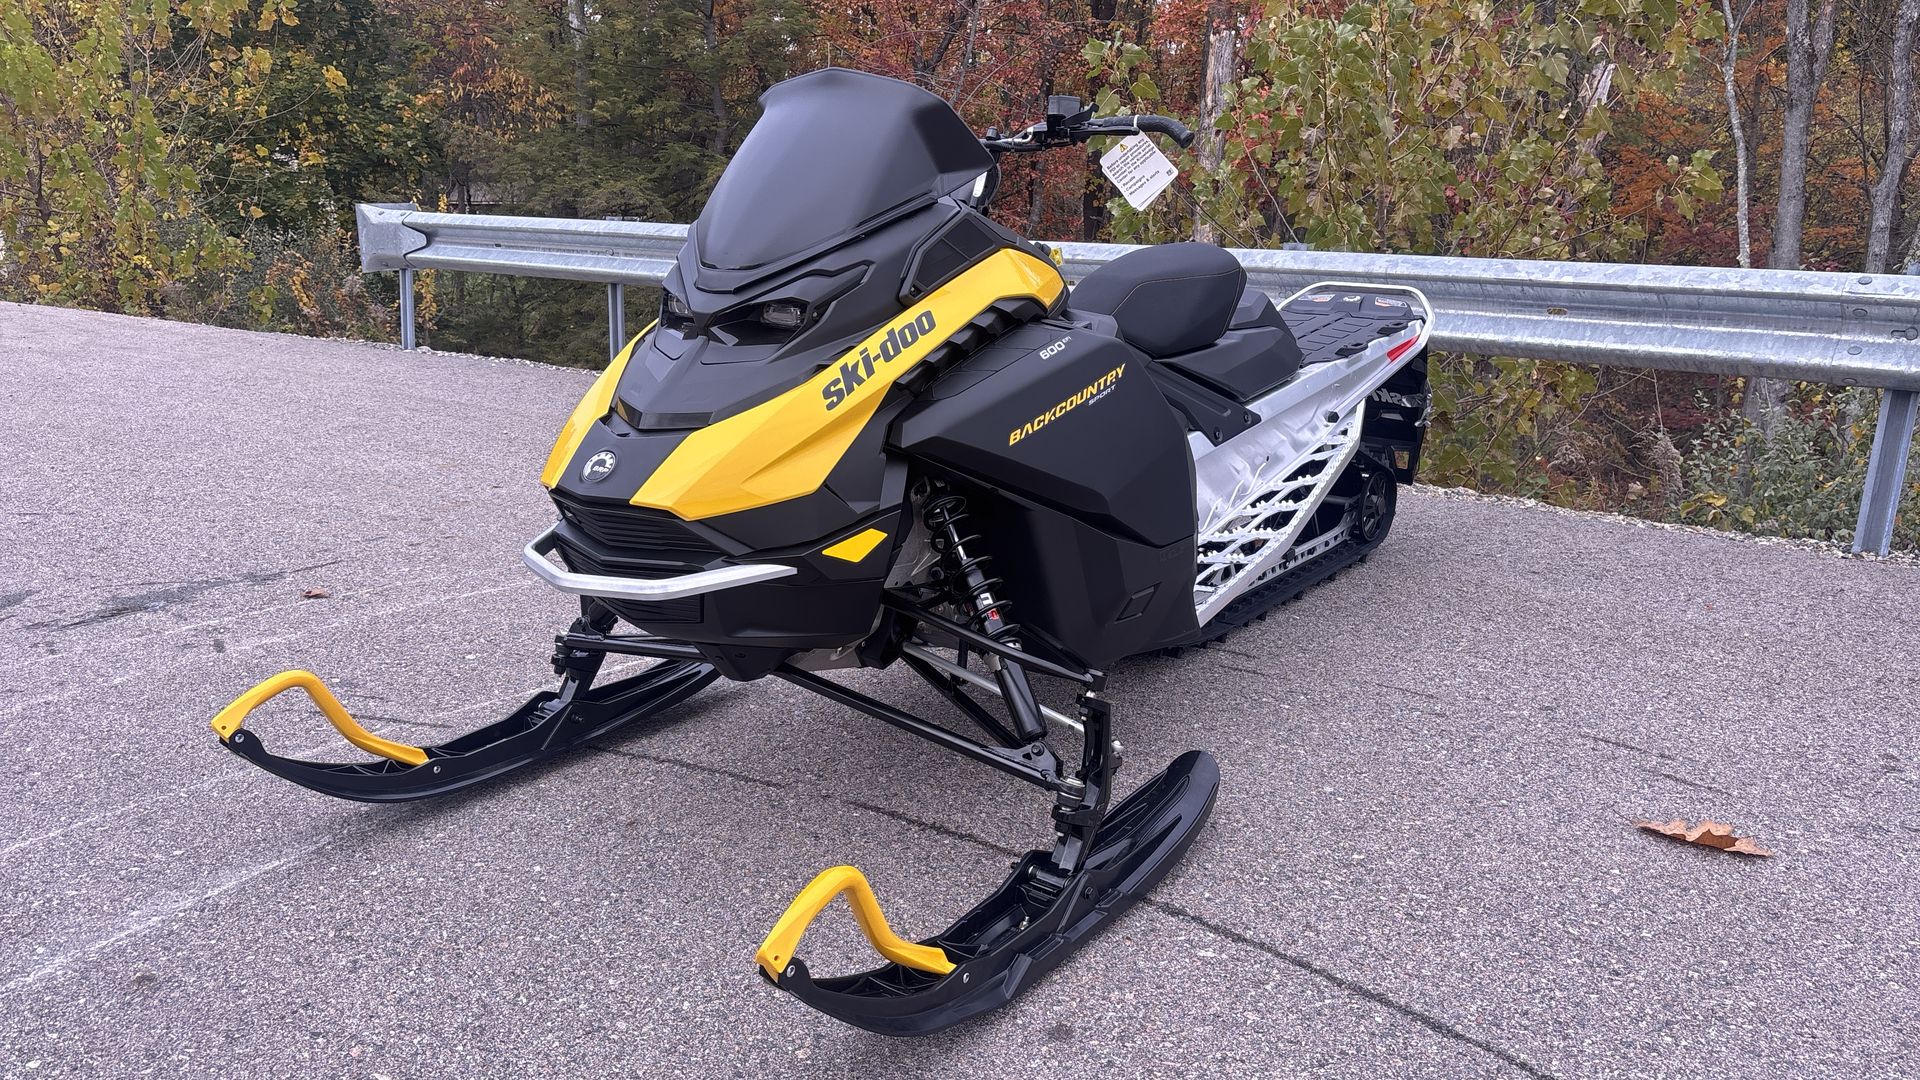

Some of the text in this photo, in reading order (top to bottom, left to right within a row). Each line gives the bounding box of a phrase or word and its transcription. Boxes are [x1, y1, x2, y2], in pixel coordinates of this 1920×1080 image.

[1040, 341, 1065, 360] 600
[1009, 363, 1126, 446] BACKCOUNTRY
[1088, 384, 1116, 406] SPORT
